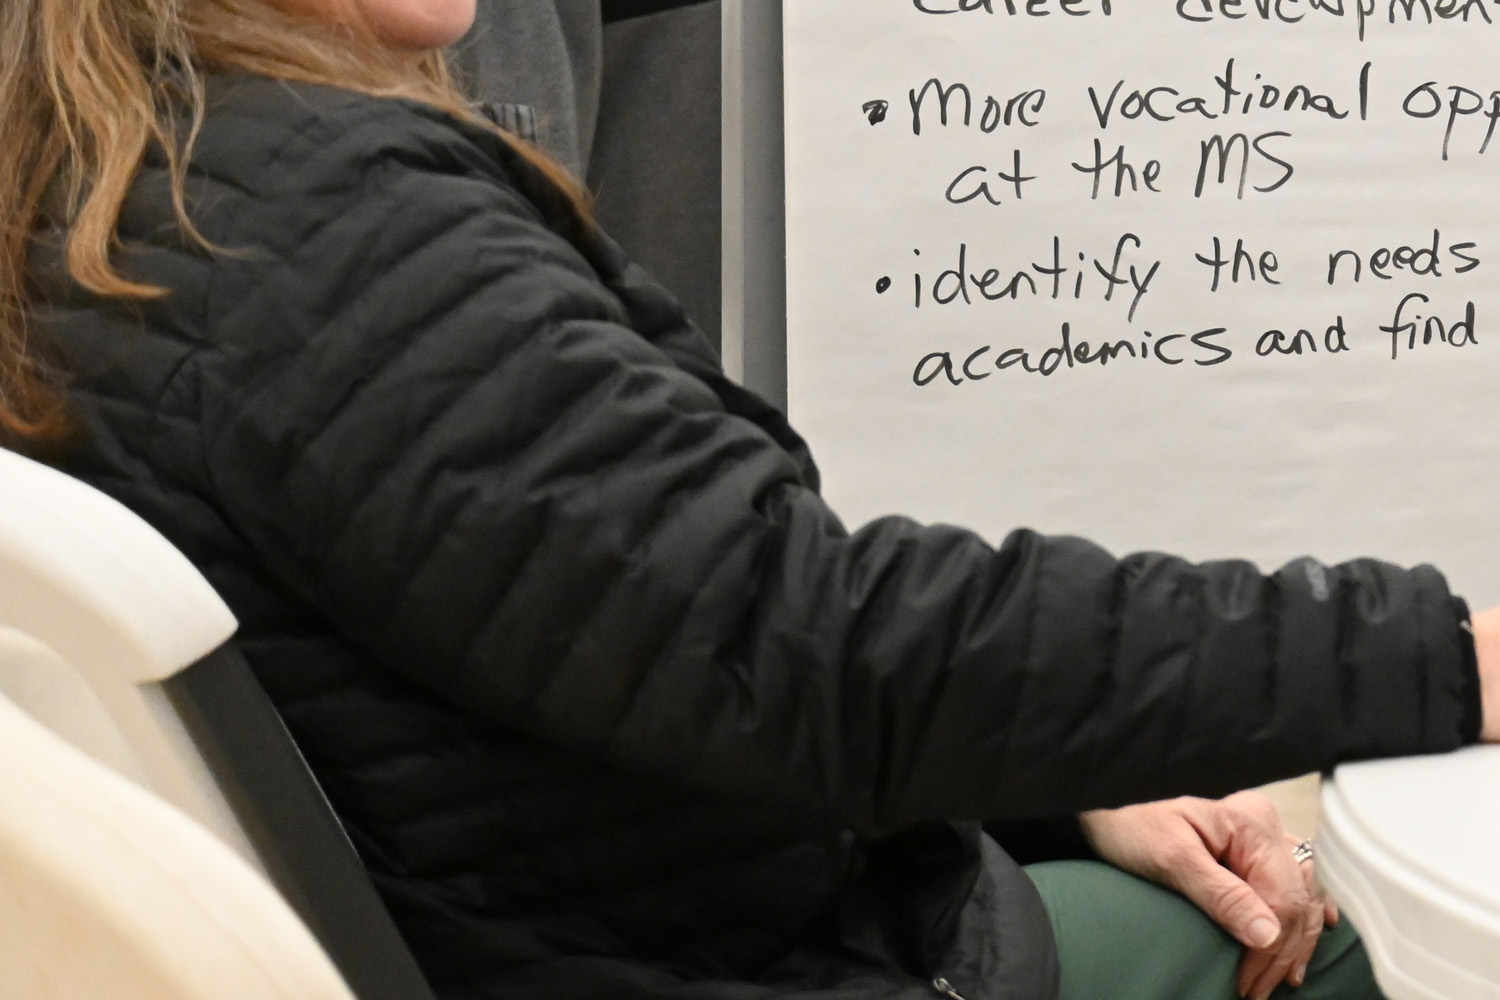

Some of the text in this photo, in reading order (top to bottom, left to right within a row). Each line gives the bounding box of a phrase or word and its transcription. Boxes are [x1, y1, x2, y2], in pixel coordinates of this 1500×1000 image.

[944, 130, 1294, 206] at the MS
[913, 232, 1161, 327] identify
[1194, 236, 1281, 293] the
[1327, 228, 1481, 286] needs
[912, 317, 1233, 387] academics
[1255, 315, 1351, 357] and
[1378, 292, 1479, 360] find
